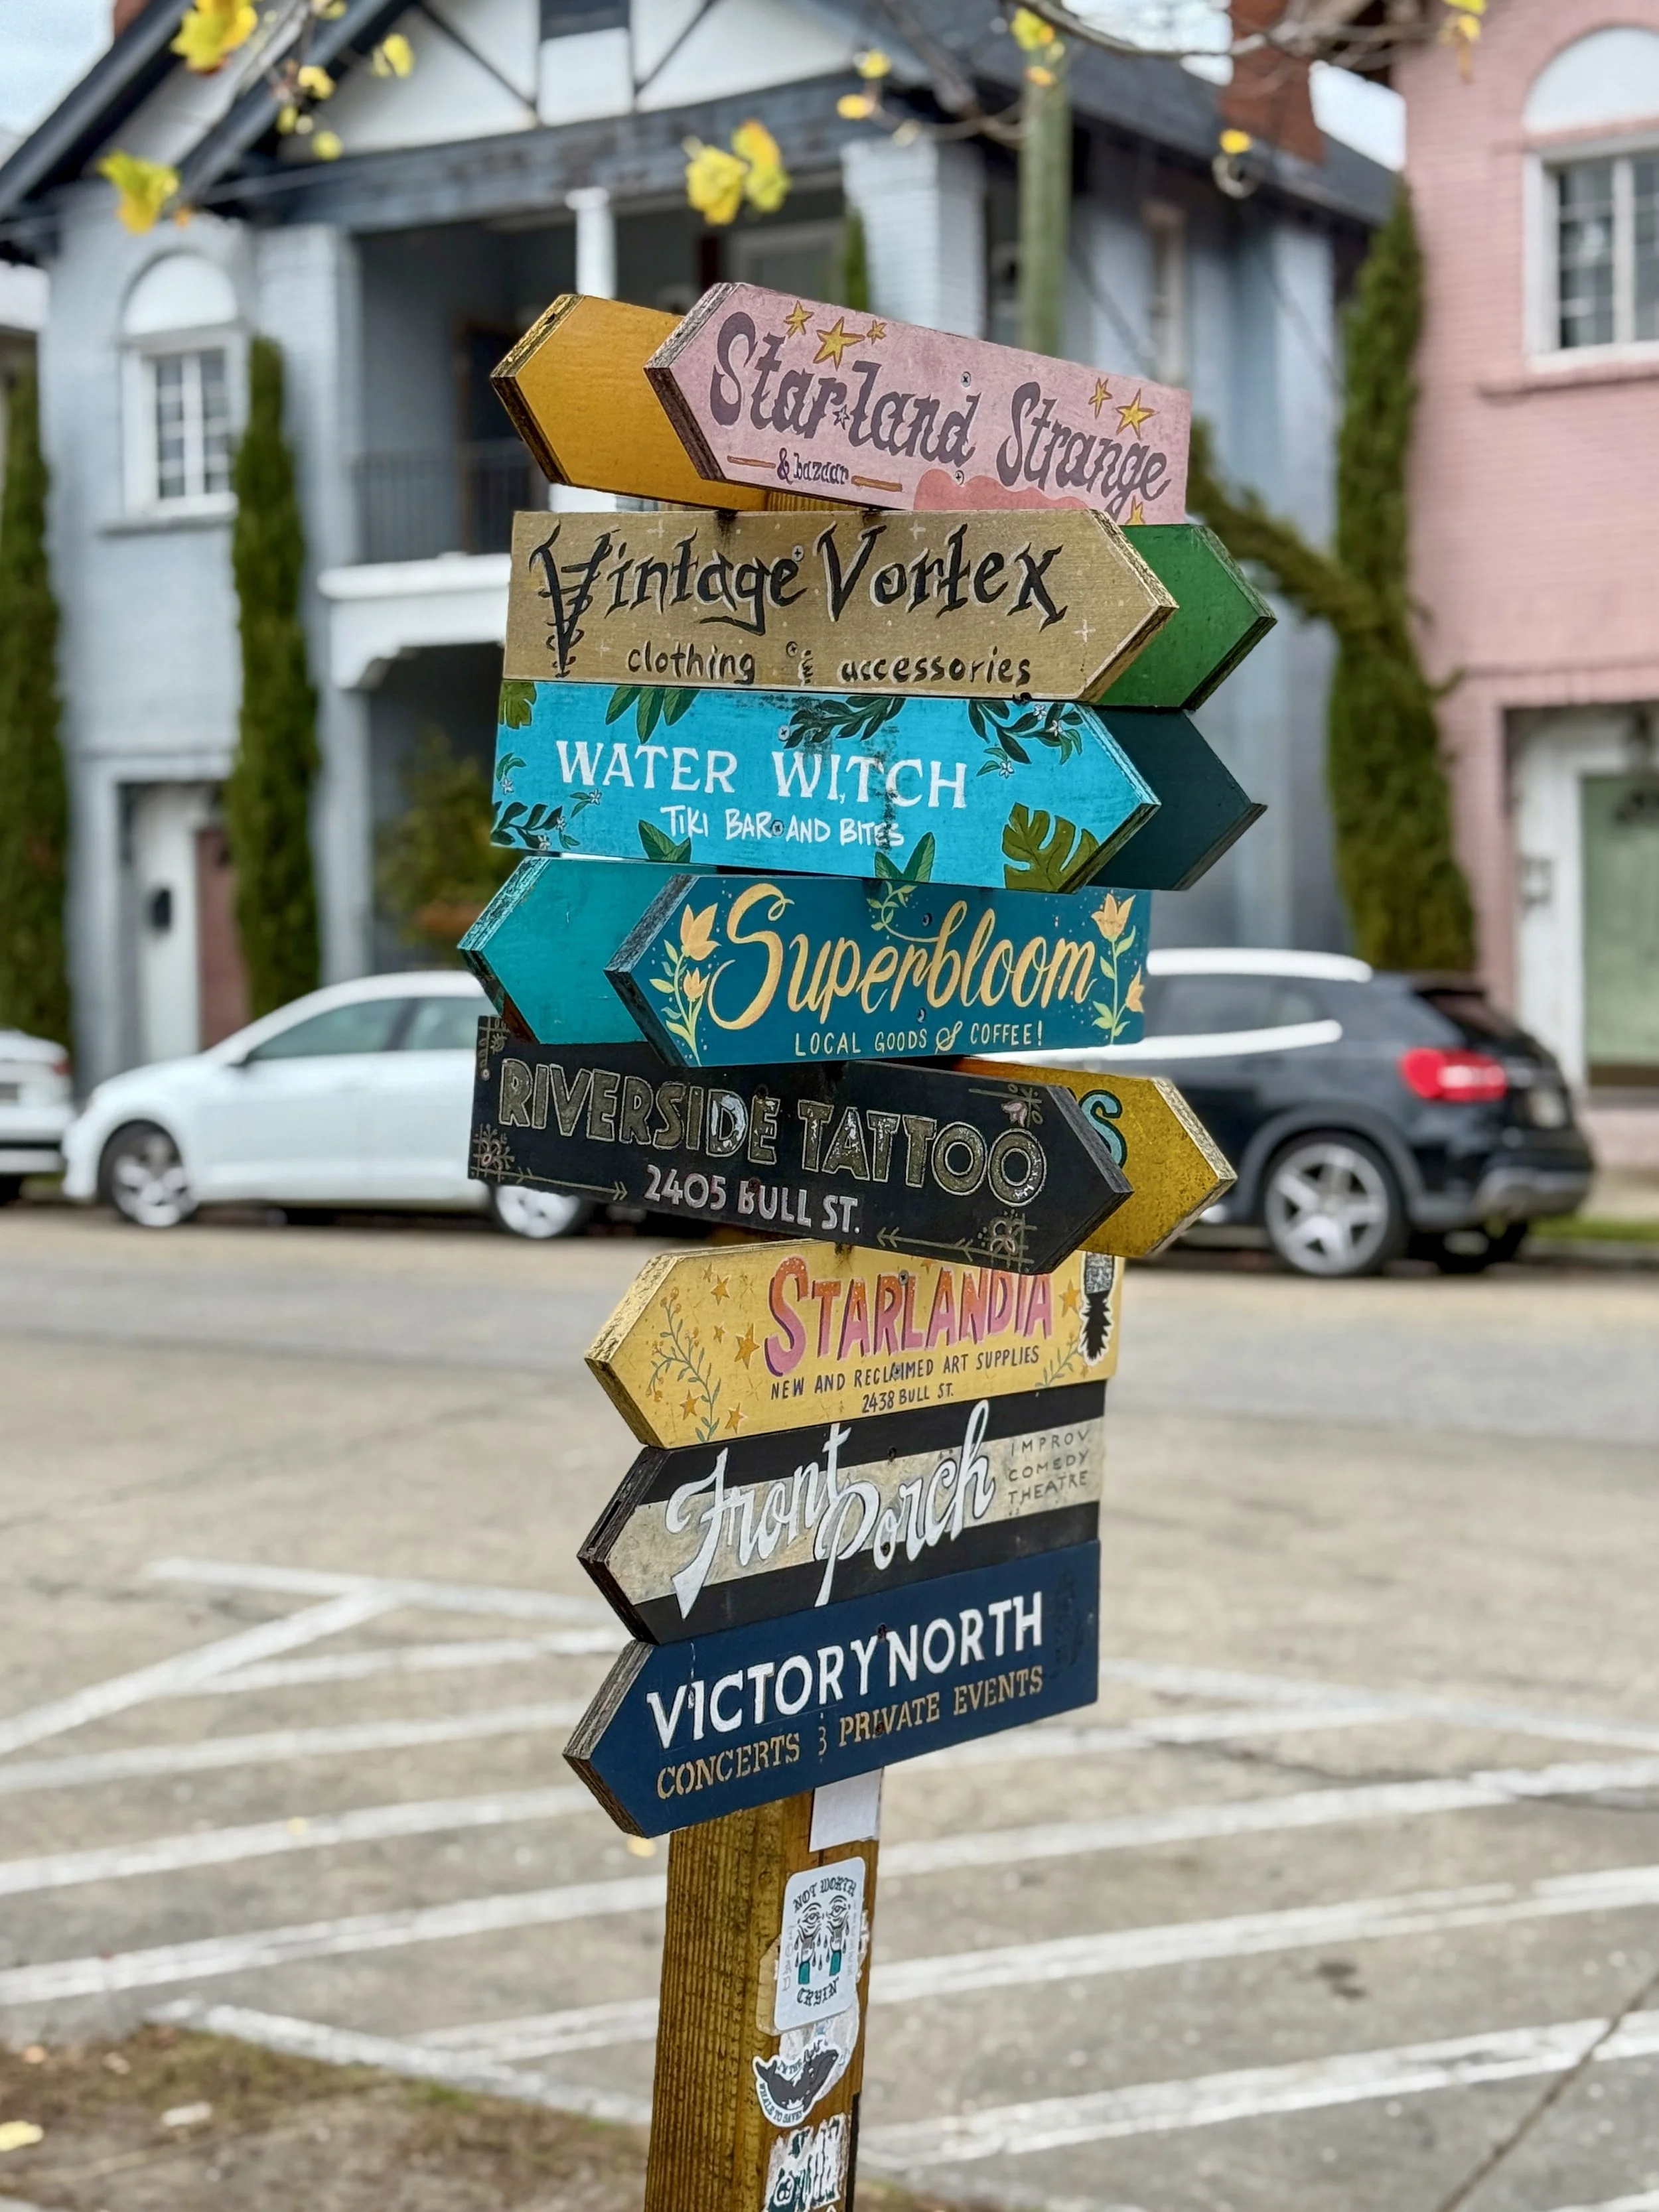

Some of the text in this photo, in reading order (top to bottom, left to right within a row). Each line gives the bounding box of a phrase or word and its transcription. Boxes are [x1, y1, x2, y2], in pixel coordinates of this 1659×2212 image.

[710, 312, 1172, 520] Starland Strange
[777, 447, 849, 485] & bazaar
[530, 519, 1068, 676] Vintage Vortex
[627, 641, 755, 684] clothing
[839, 646, 1031, 685] accessories
[556, 740, 968, 809] WATER WITCH
[725, 808, 772, 841] BAR
[786, 815, 831, 844] AND
[839, 818, 904, 847] BITES
[708, 883, 1098, 1030] Superbloom
[796, 1032, 861, 1056] LOCAL
[874, 1028, 928, 1053] GOODS
[970, 1020, 1043, 1046] COFFEE!
[498, 1058, 1047, 1208] RIVERSIDE TATTOO
[644, 1164, 860, 1235] 2405 BULL ST.
[764, 1254, 1054, 1377] STARLANDIA
[770, 1346, 1040, 1400] NEW AND RECLAIMED ART SUPPLIES
[862, 1382, 954, 1413] 2438 BULL ST.
[1008, 1449, 1089, 1482] COMEDY
[1011, 1429, 1090, 1457] IMPROV
[665, 1399, 995, 1620] Front Porch
[1008, 1470, 1088, 1505] THEATRE
[656, 1732, 800, 1800] CONCERTS
[838, 1691, 940, 1748] PRIVATE
[954, 1665, 1044, 1716] EVENTS
[793, 1876, 857, 1913] NOT WORTH
